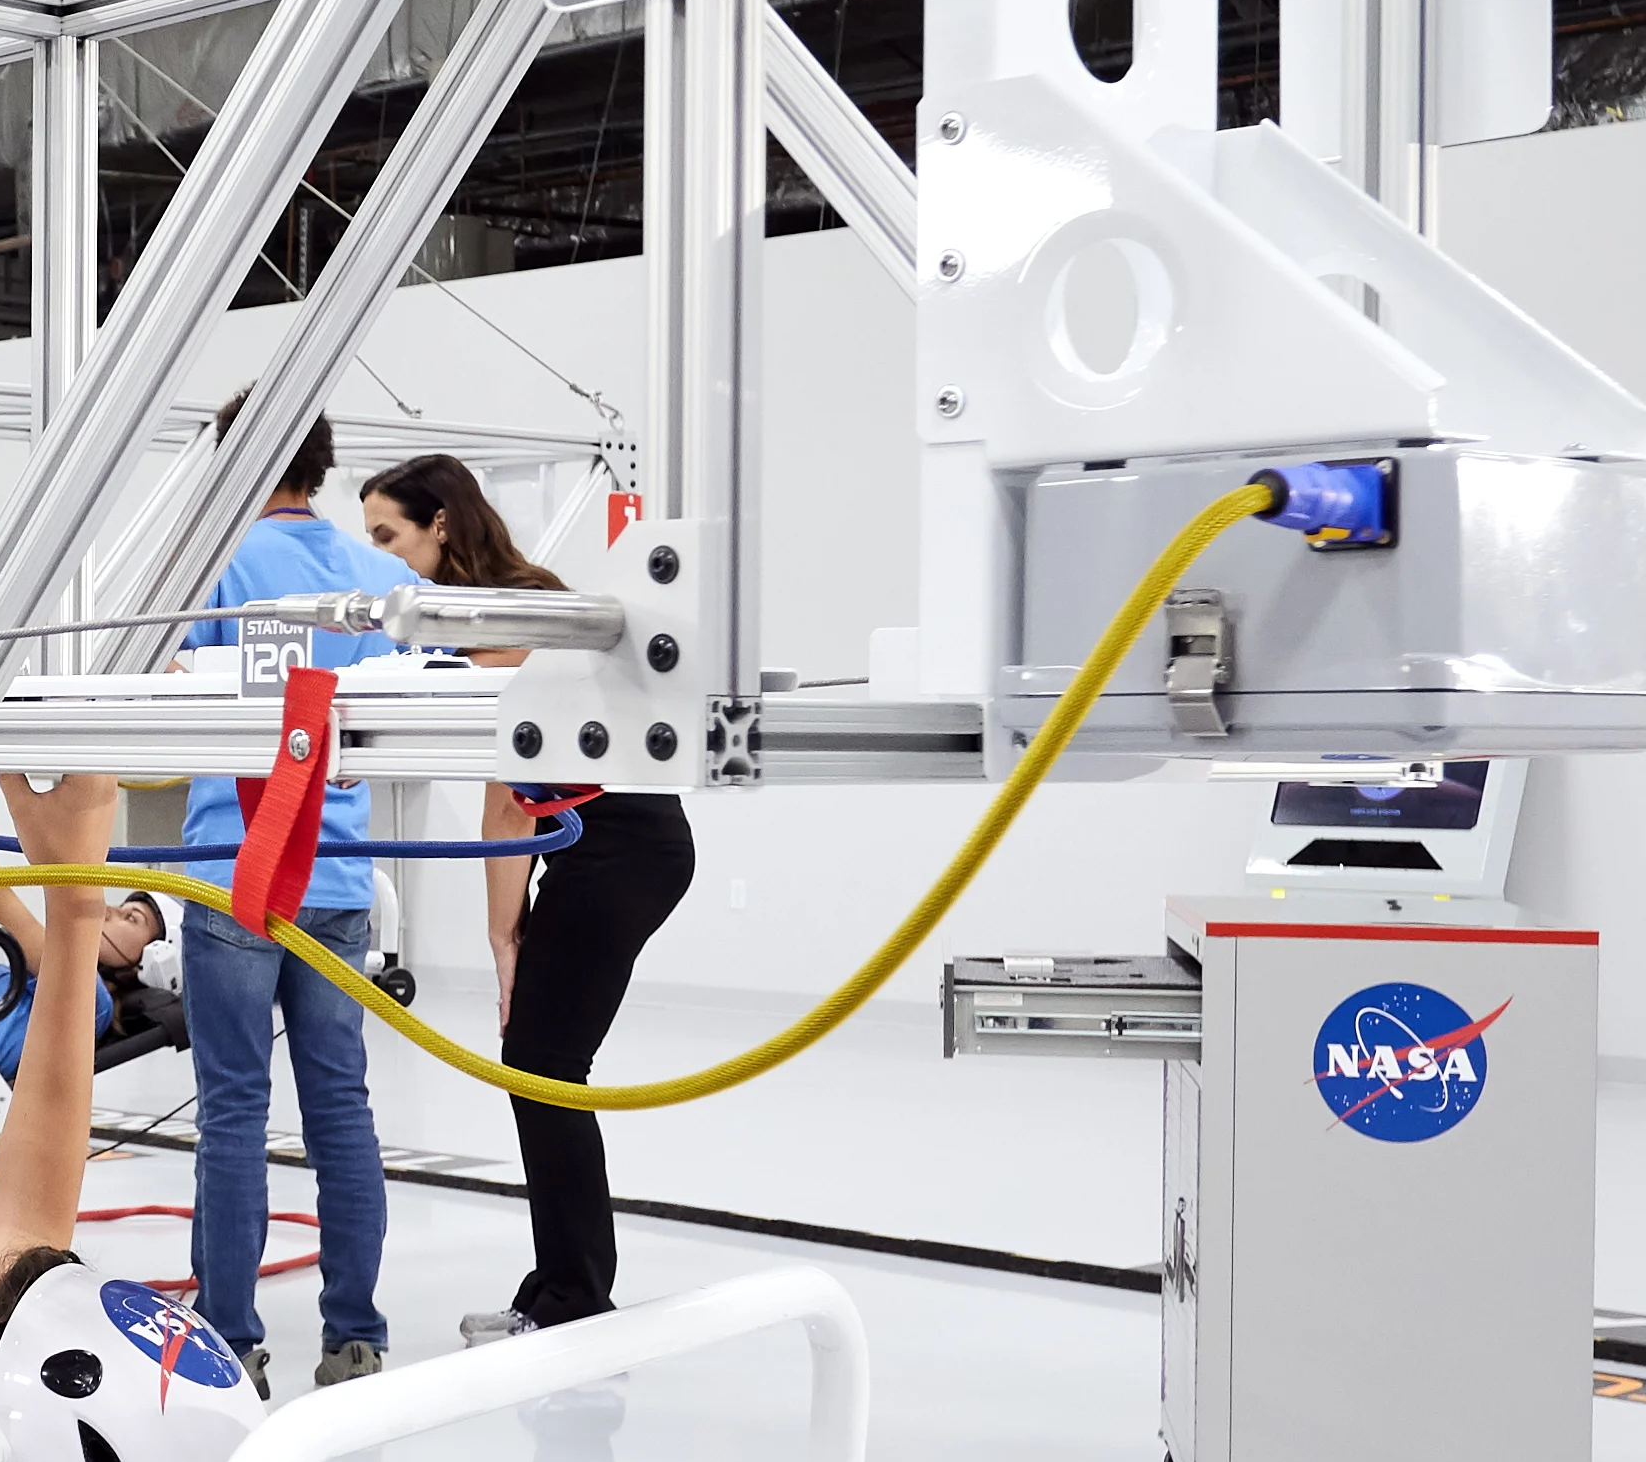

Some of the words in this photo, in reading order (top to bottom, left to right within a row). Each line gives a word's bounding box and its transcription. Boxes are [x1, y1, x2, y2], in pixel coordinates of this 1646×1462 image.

[246, 620, 304, 636] STATION
[243, 642, 306, 684] 120
[1326, 1043, 1478, 1083] NASA
[127, 1306, 204, 1347] ASA
